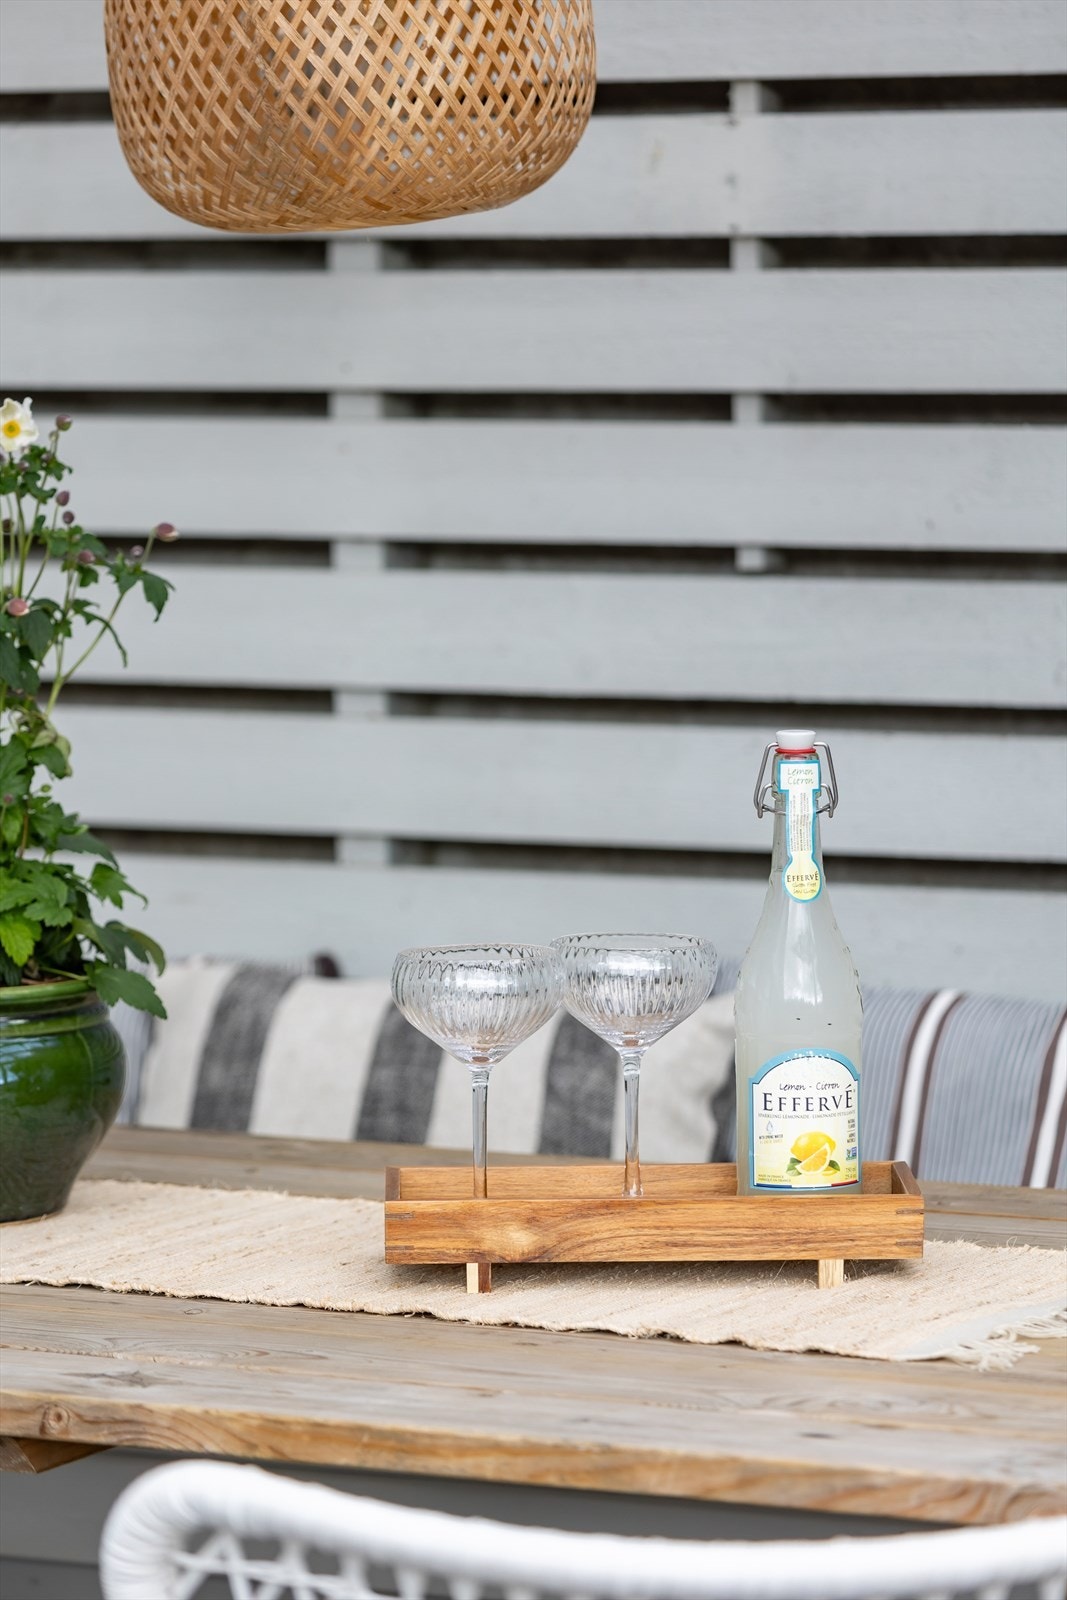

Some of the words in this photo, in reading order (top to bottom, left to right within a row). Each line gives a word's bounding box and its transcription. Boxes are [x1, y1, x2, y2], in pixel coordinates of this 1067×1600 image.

[787, 767, 814, 775] Lemon
[787, 776, 815, 785] Citron
[786, 870, 818, 882] EFFERVÉ
[779, 1082, 806, 1091] Lemon
[816, 1081, 840, 1090] Citron
[763, 1084, 853, 1112] EFFERVÉ
